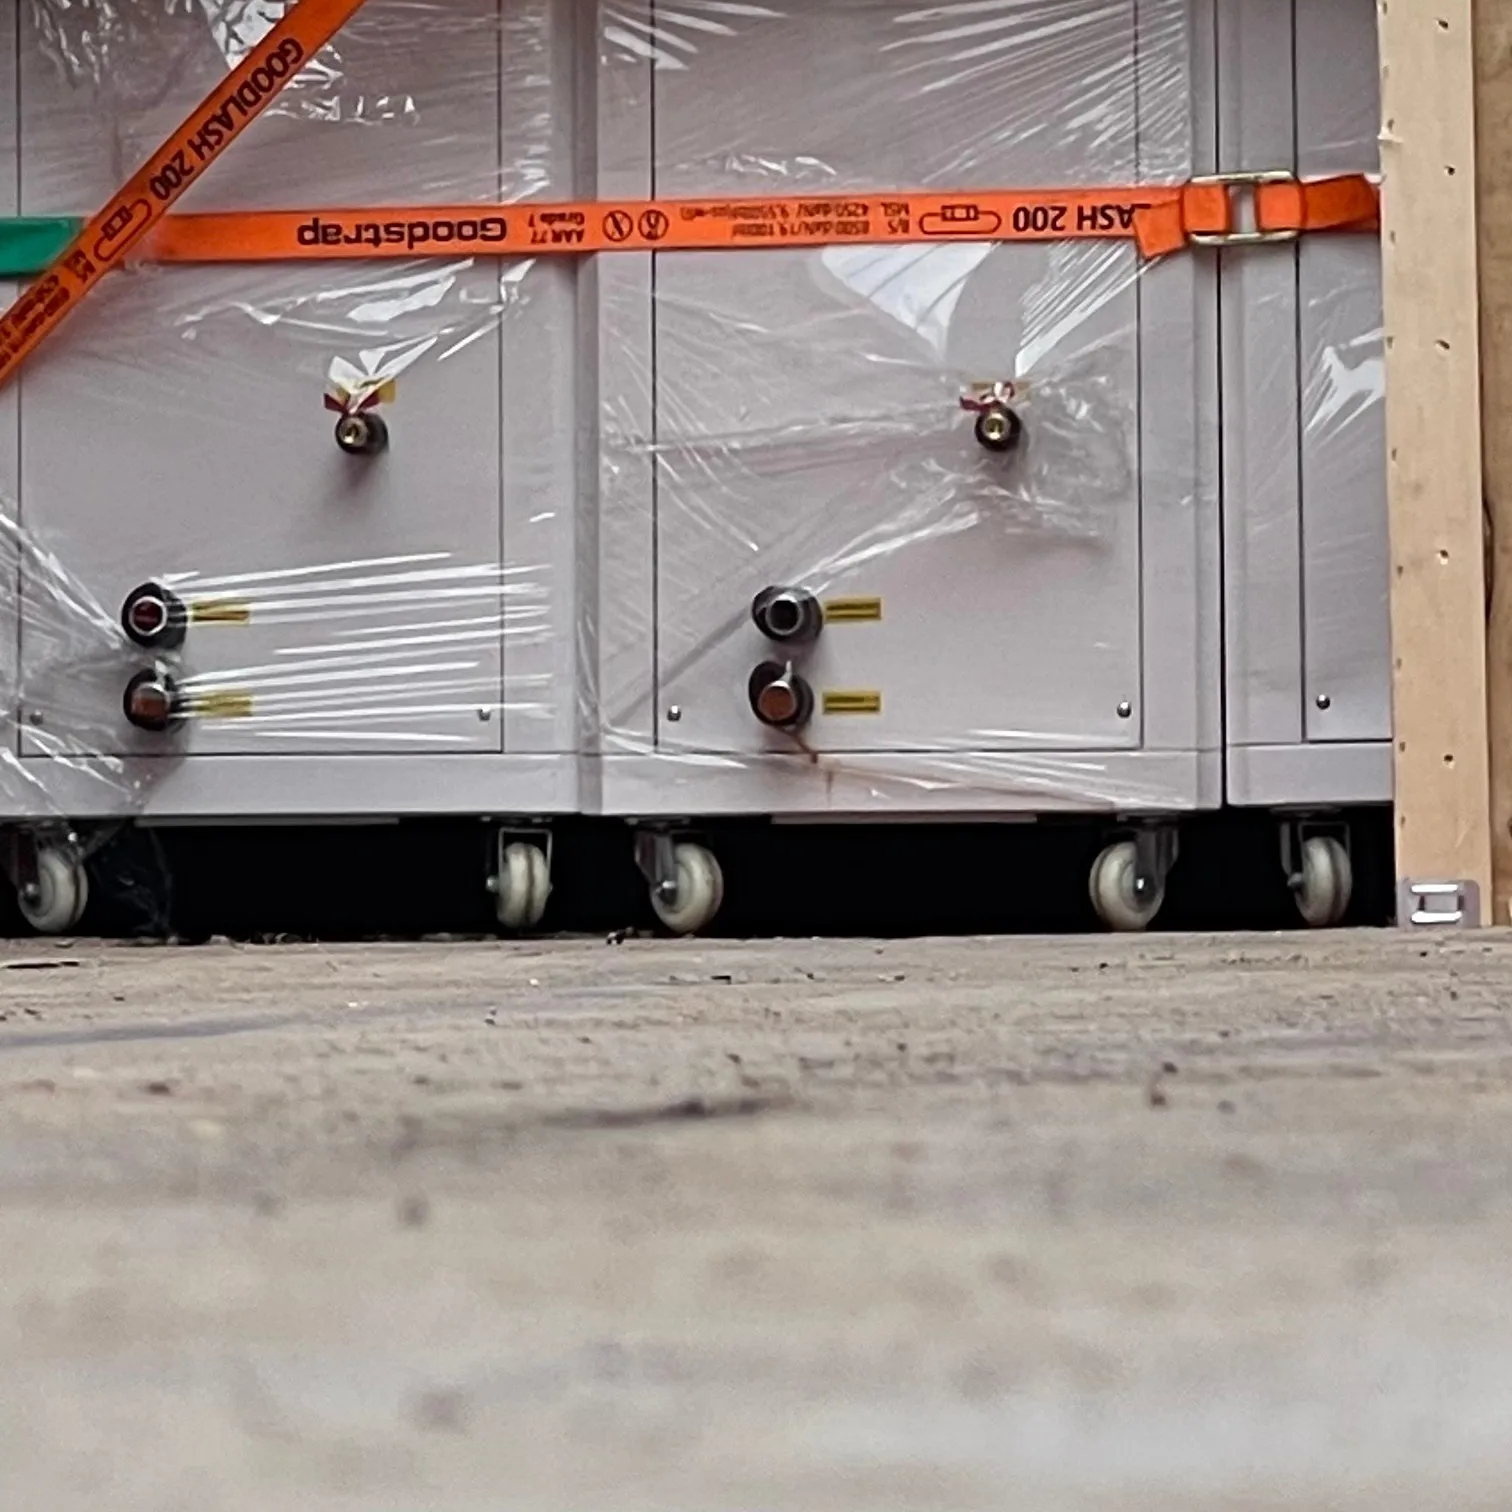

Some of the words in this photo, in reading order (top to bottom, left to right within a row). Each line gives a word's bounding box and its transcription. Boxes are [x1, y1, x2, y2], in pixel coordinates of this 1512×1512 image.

[187, 37, 304, 160] GOODLASH
[150, 149, 195, 200] 200
[297, 217, 507, 249] Goodstrap
[1013, 205, 1067, 232] 200
[530, 229, 548, 244] 77
[551, 228, 585, 244] AAR
